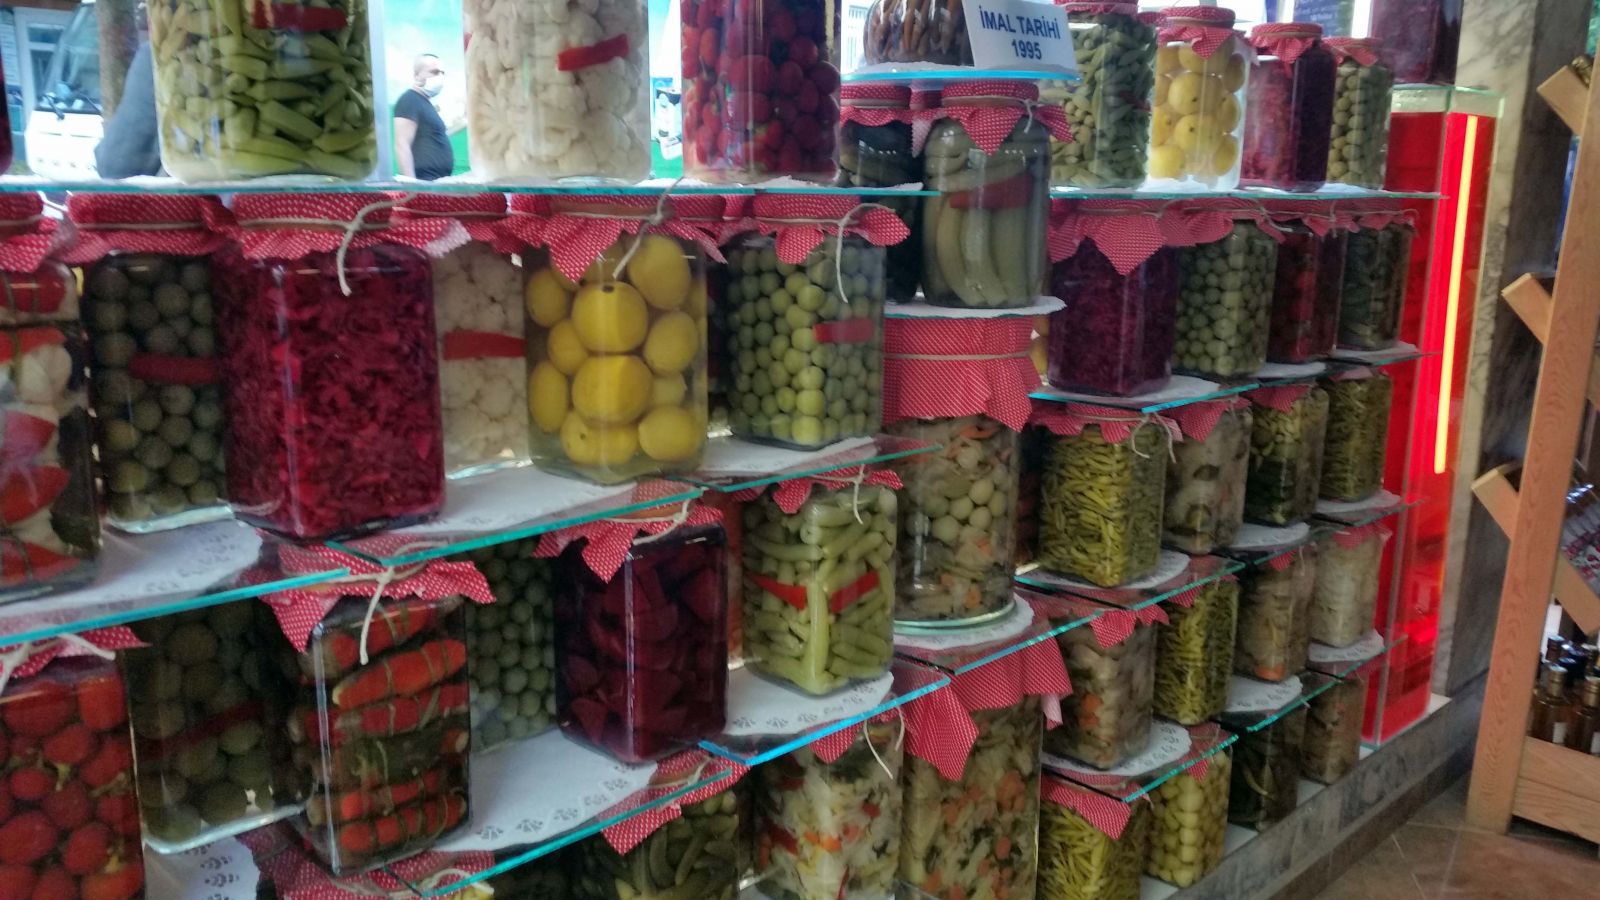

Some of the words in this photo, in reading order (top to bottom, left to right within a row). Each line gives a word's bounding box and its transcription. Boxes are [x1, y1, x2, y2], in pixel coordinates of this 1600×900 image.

[979, 5, 1016, 33] İMAL
[1016, 15, 1061, 39] TARİHİ
[1011, 39, 1042, 60] 1995
